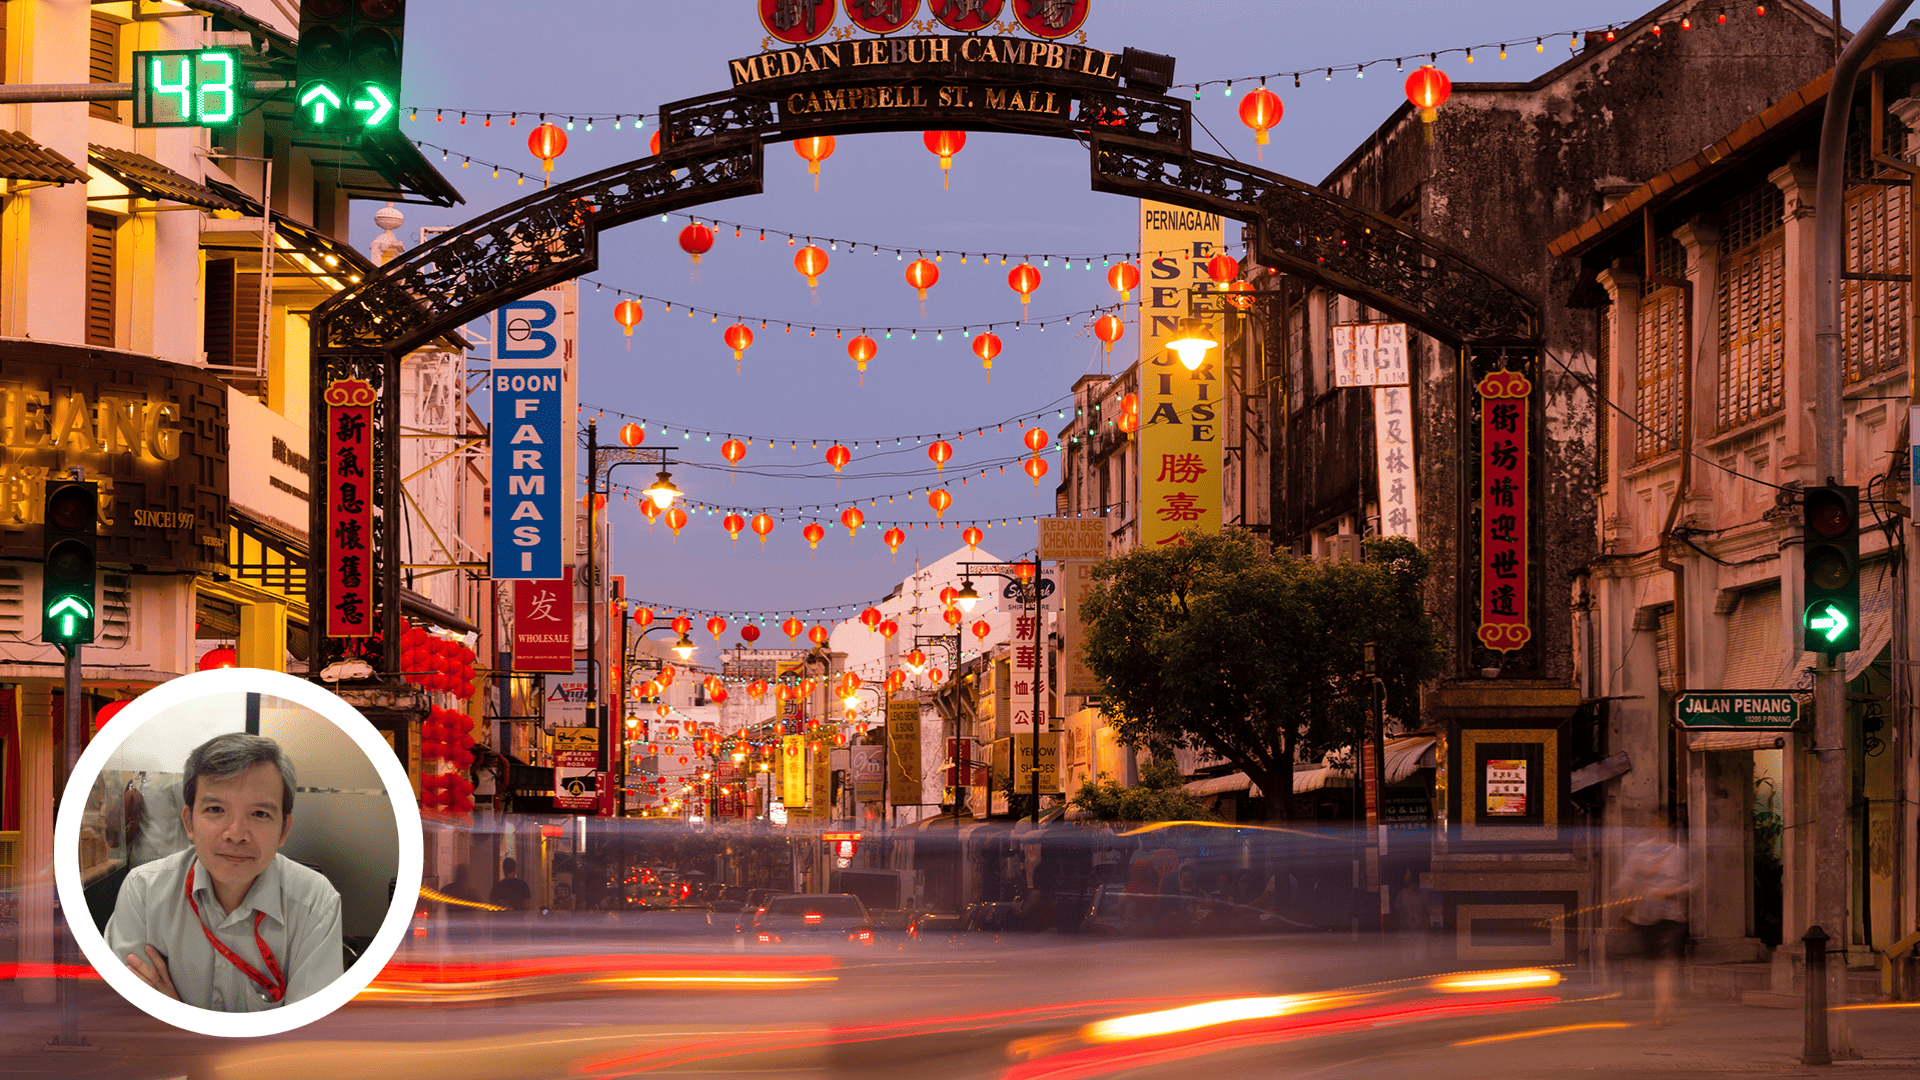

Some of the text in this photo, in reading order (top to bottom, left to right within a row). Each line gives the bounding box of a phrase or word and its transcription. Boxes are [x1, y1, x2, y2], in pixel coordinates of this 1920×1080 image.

[731, 37, 1118, 86] MEDAN LEBUH CAMPBELL
[151, 53, 234, 123] 43
[787, 85, 1061, 116] CAMPBELL ST. MALL
[1146, 210, 1220, 232] PERNIAGAAN
[1191, 241, 1217, 442] ENTERRISE
[497, 375, 557, 392] BOON
[0, 388, 182, 461] EANG
[509, 399, 544, 572] FARMASI
[335, 412, 366, 625] 新氣息懷舊意
[1490, 404, 1519, 616] 街坊情迎世遺
[1044, 521, 1103, 531] KEDAI BEG
[1043, 532, 1103, 549] CHENG HONG
[518, 634, 570, 643] WHOLESALE
[1685, 699, 1791, 713] JALAN PENANG
[1020, 747, 1056, 756] YELOW
[1021, 764, 1056, 773] SHDES
